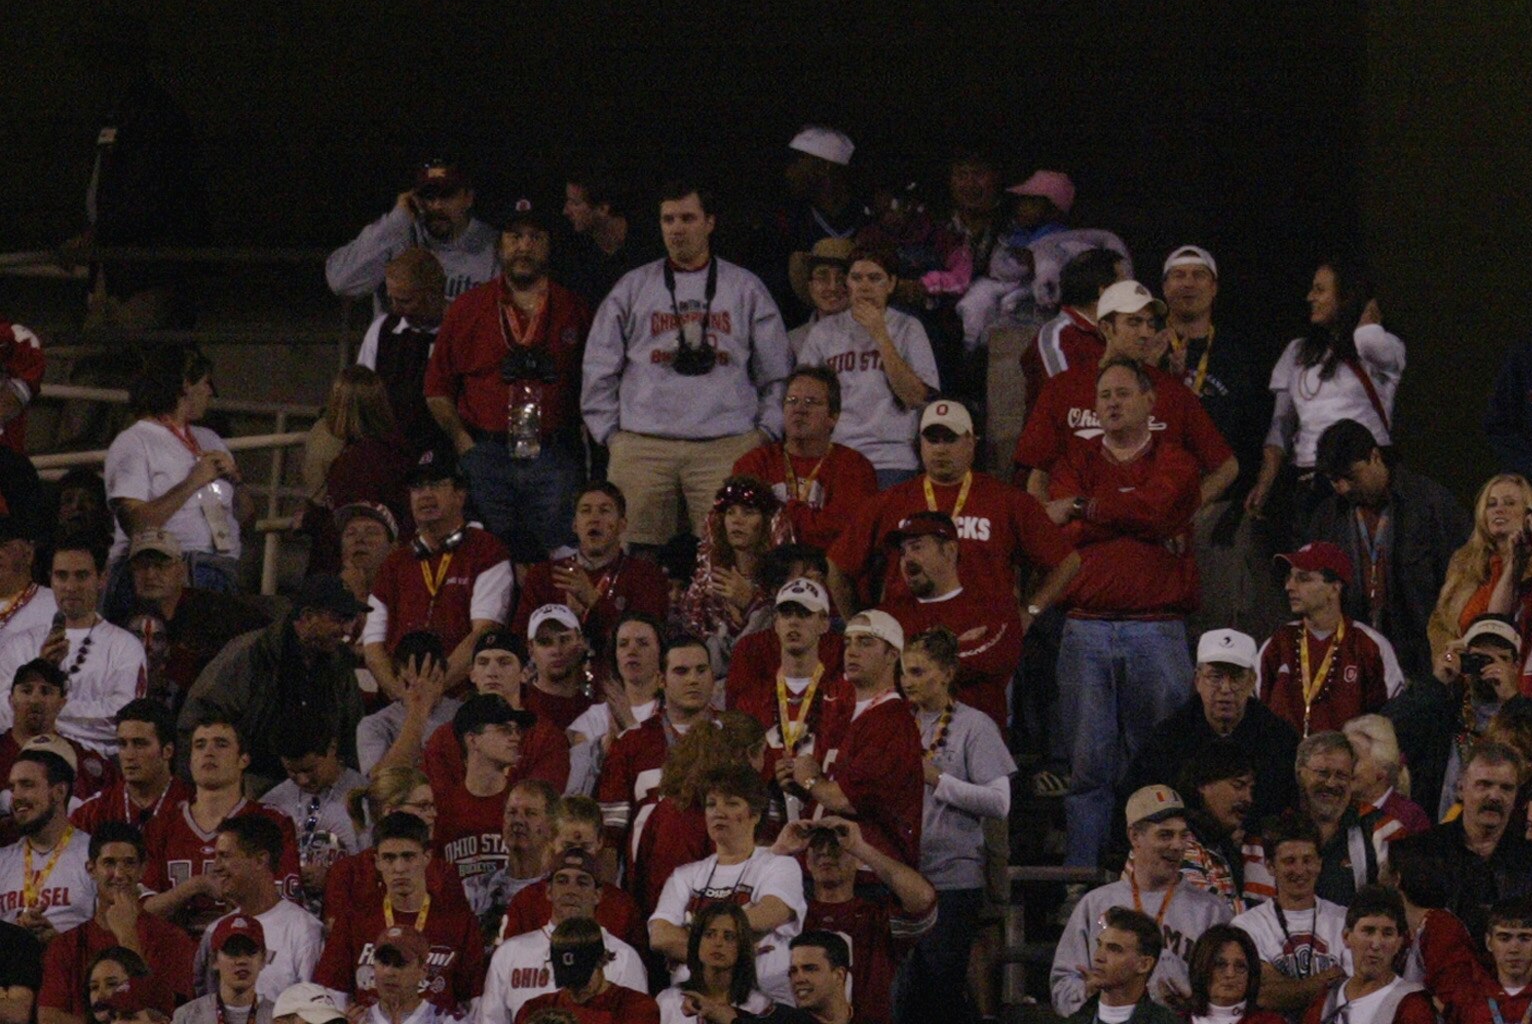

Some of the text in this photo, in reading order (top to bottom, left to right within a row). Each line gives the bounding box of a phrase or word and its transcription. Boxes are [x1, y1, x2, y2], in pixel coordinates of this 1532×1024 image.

[444, 833, 510, 865] OHIO STA
[511, 967, 551, 990] OHIO
